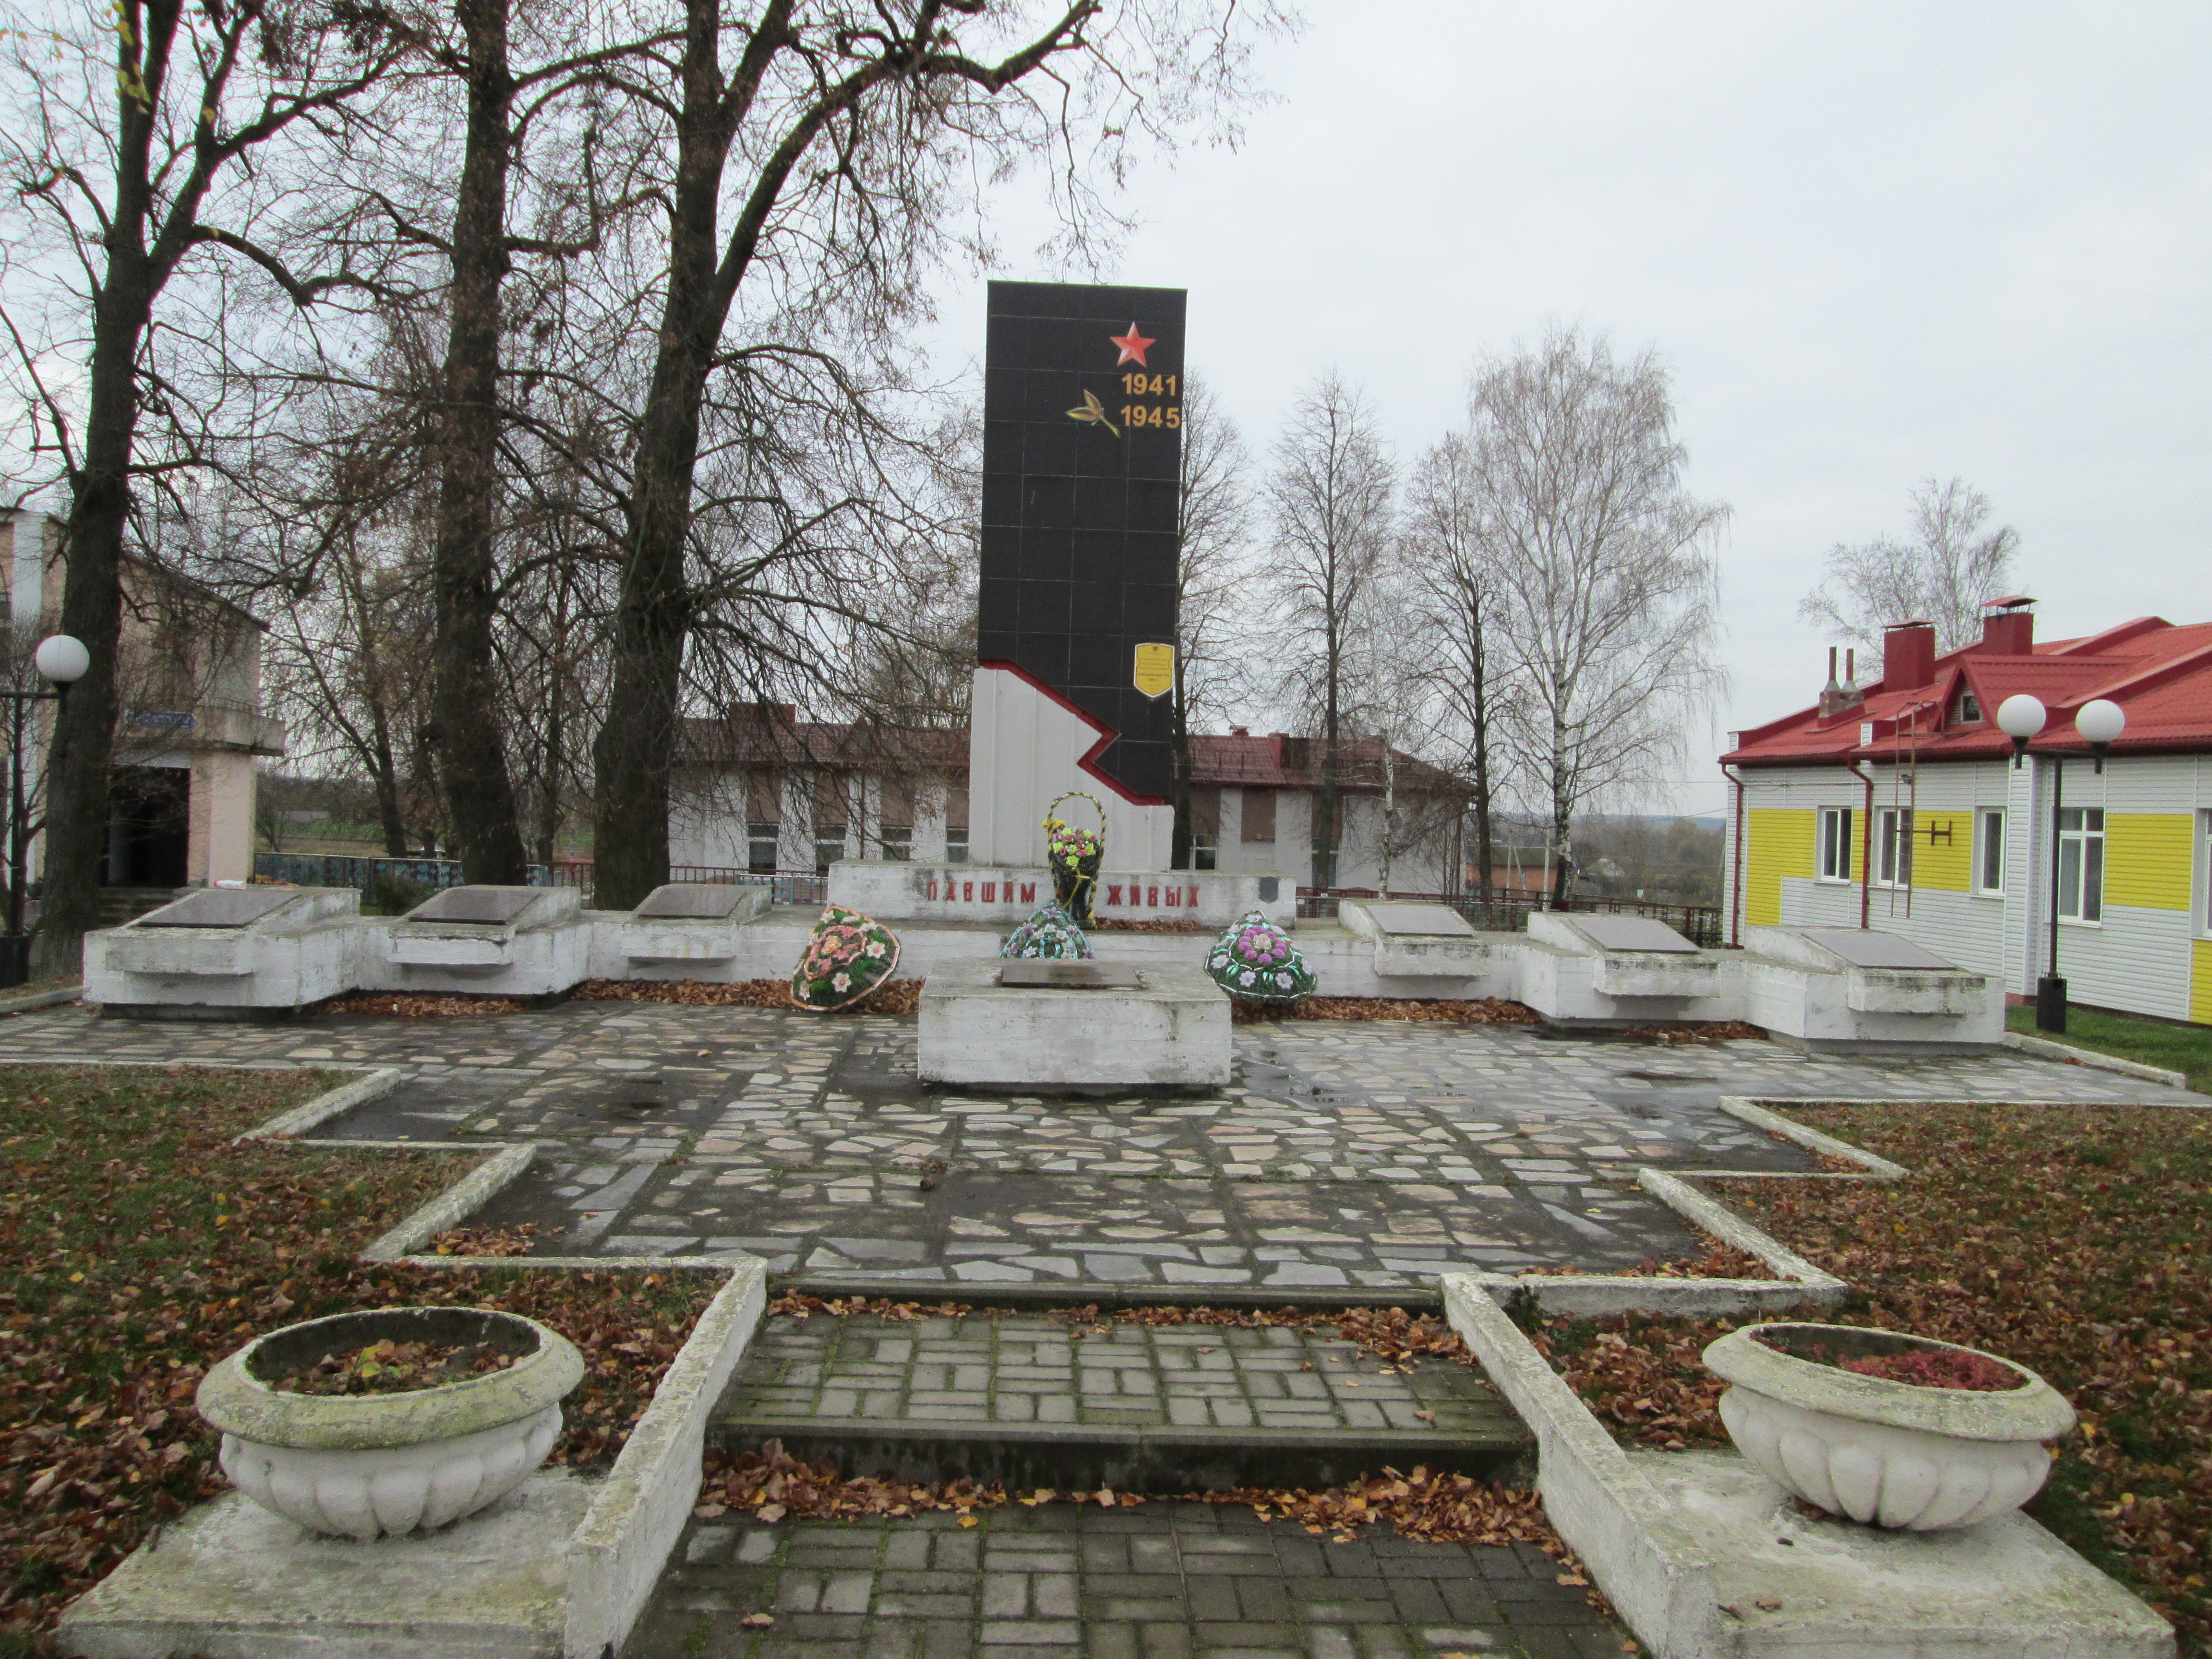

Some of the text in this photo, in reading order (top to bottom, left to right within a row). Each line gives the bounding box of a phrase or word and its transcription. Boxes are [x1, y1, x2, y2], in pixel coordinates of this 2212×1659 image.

[1122, 373, 1176, 396] 1941
[1121, 405, 1180, 429] 1945
[927, 880, 1035, 902] ПАВШИМ
[1107, 885, 1199, 907] ЖИВЫХ
